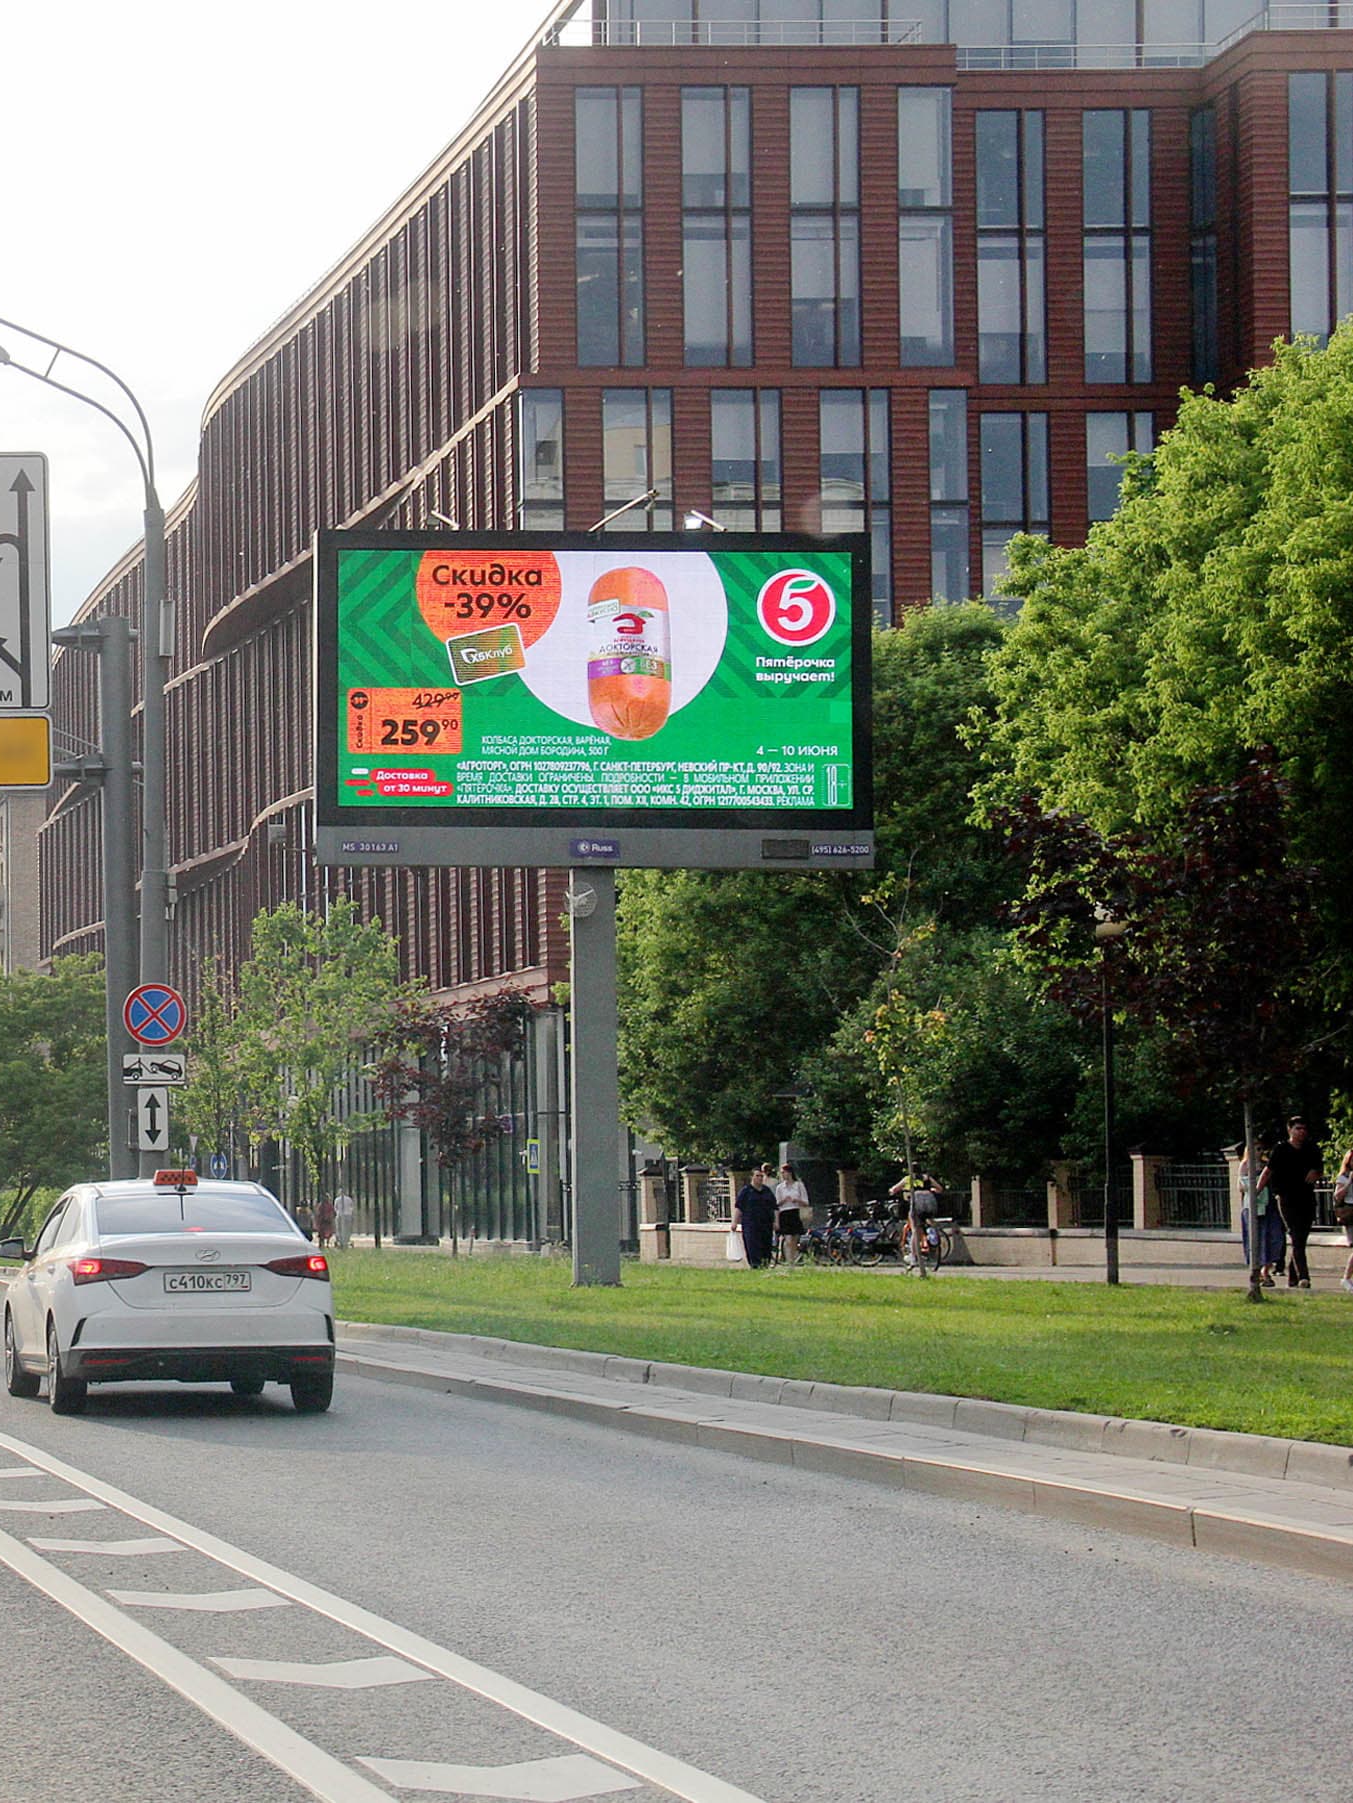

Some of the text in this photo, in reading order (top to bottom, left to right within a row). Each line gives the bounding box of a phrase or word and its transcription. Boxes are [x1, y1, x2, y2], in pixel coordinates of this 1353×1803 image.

[432, 563, 543, 586] Скидка
[444, 592, 532, 619] -39%
[755, 656, 835, 670] Пятёрочка
[755, 672, 835, 684] выручает!
[0, 690, 14, 702] м
[481, 735, 517, 745] КОЛБАСА
[519, 746, 539, 756] ДОМ
[756, 746, 764, 756] 4
[782, 746, 795, 756] 10
[798, 746, 838, 756] ИЮНЯ
[376, 771, 428, 780] Доставка
[383, 784, 447, 795] от 30 минут
[591, 843, 613, 852] Russ
